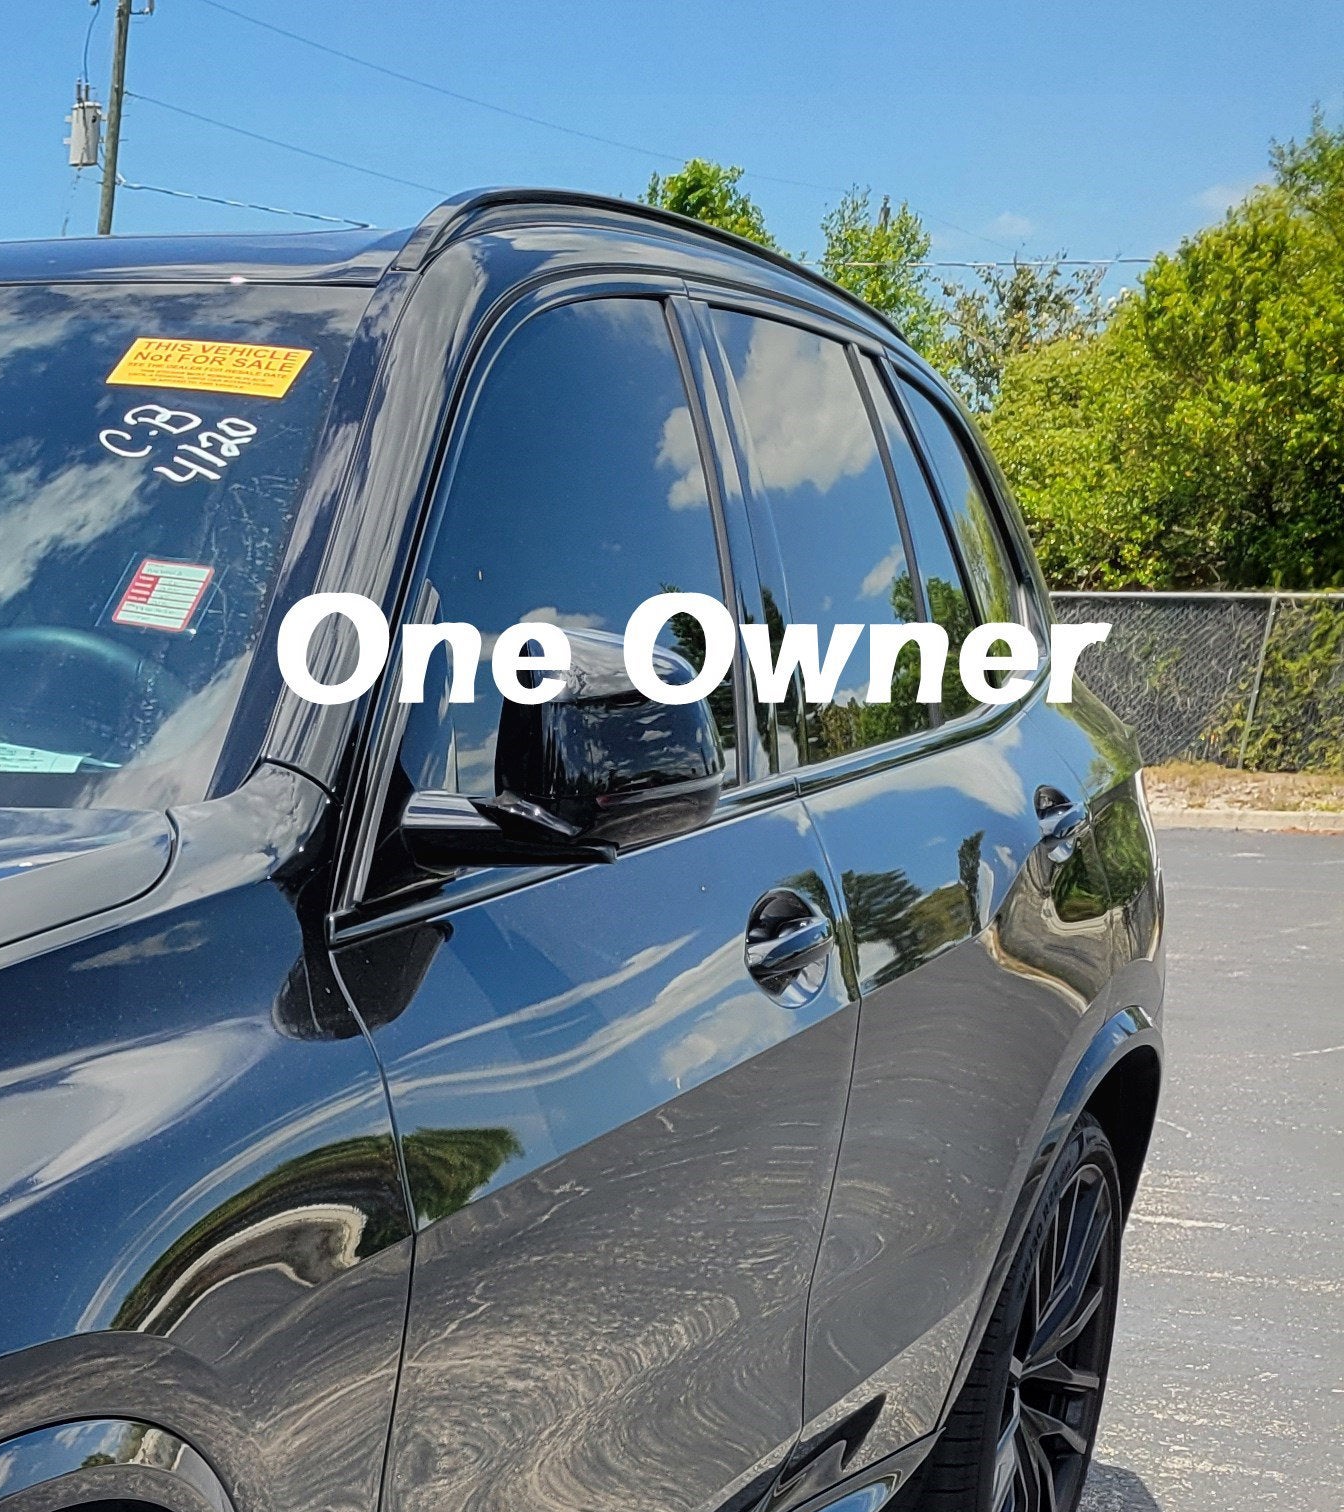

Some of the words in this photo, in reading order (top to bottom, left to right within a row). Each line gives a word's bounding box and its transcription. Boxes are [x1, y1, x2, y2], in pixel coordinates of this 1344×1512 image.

[143, 341, 194, 353] THIS
[201, 344, 300, 361] VEHICLE
[133, 351, 173, 362] Not
[177, 354, 226, 366] FOR
[232, 358, 296, 373] SALE
